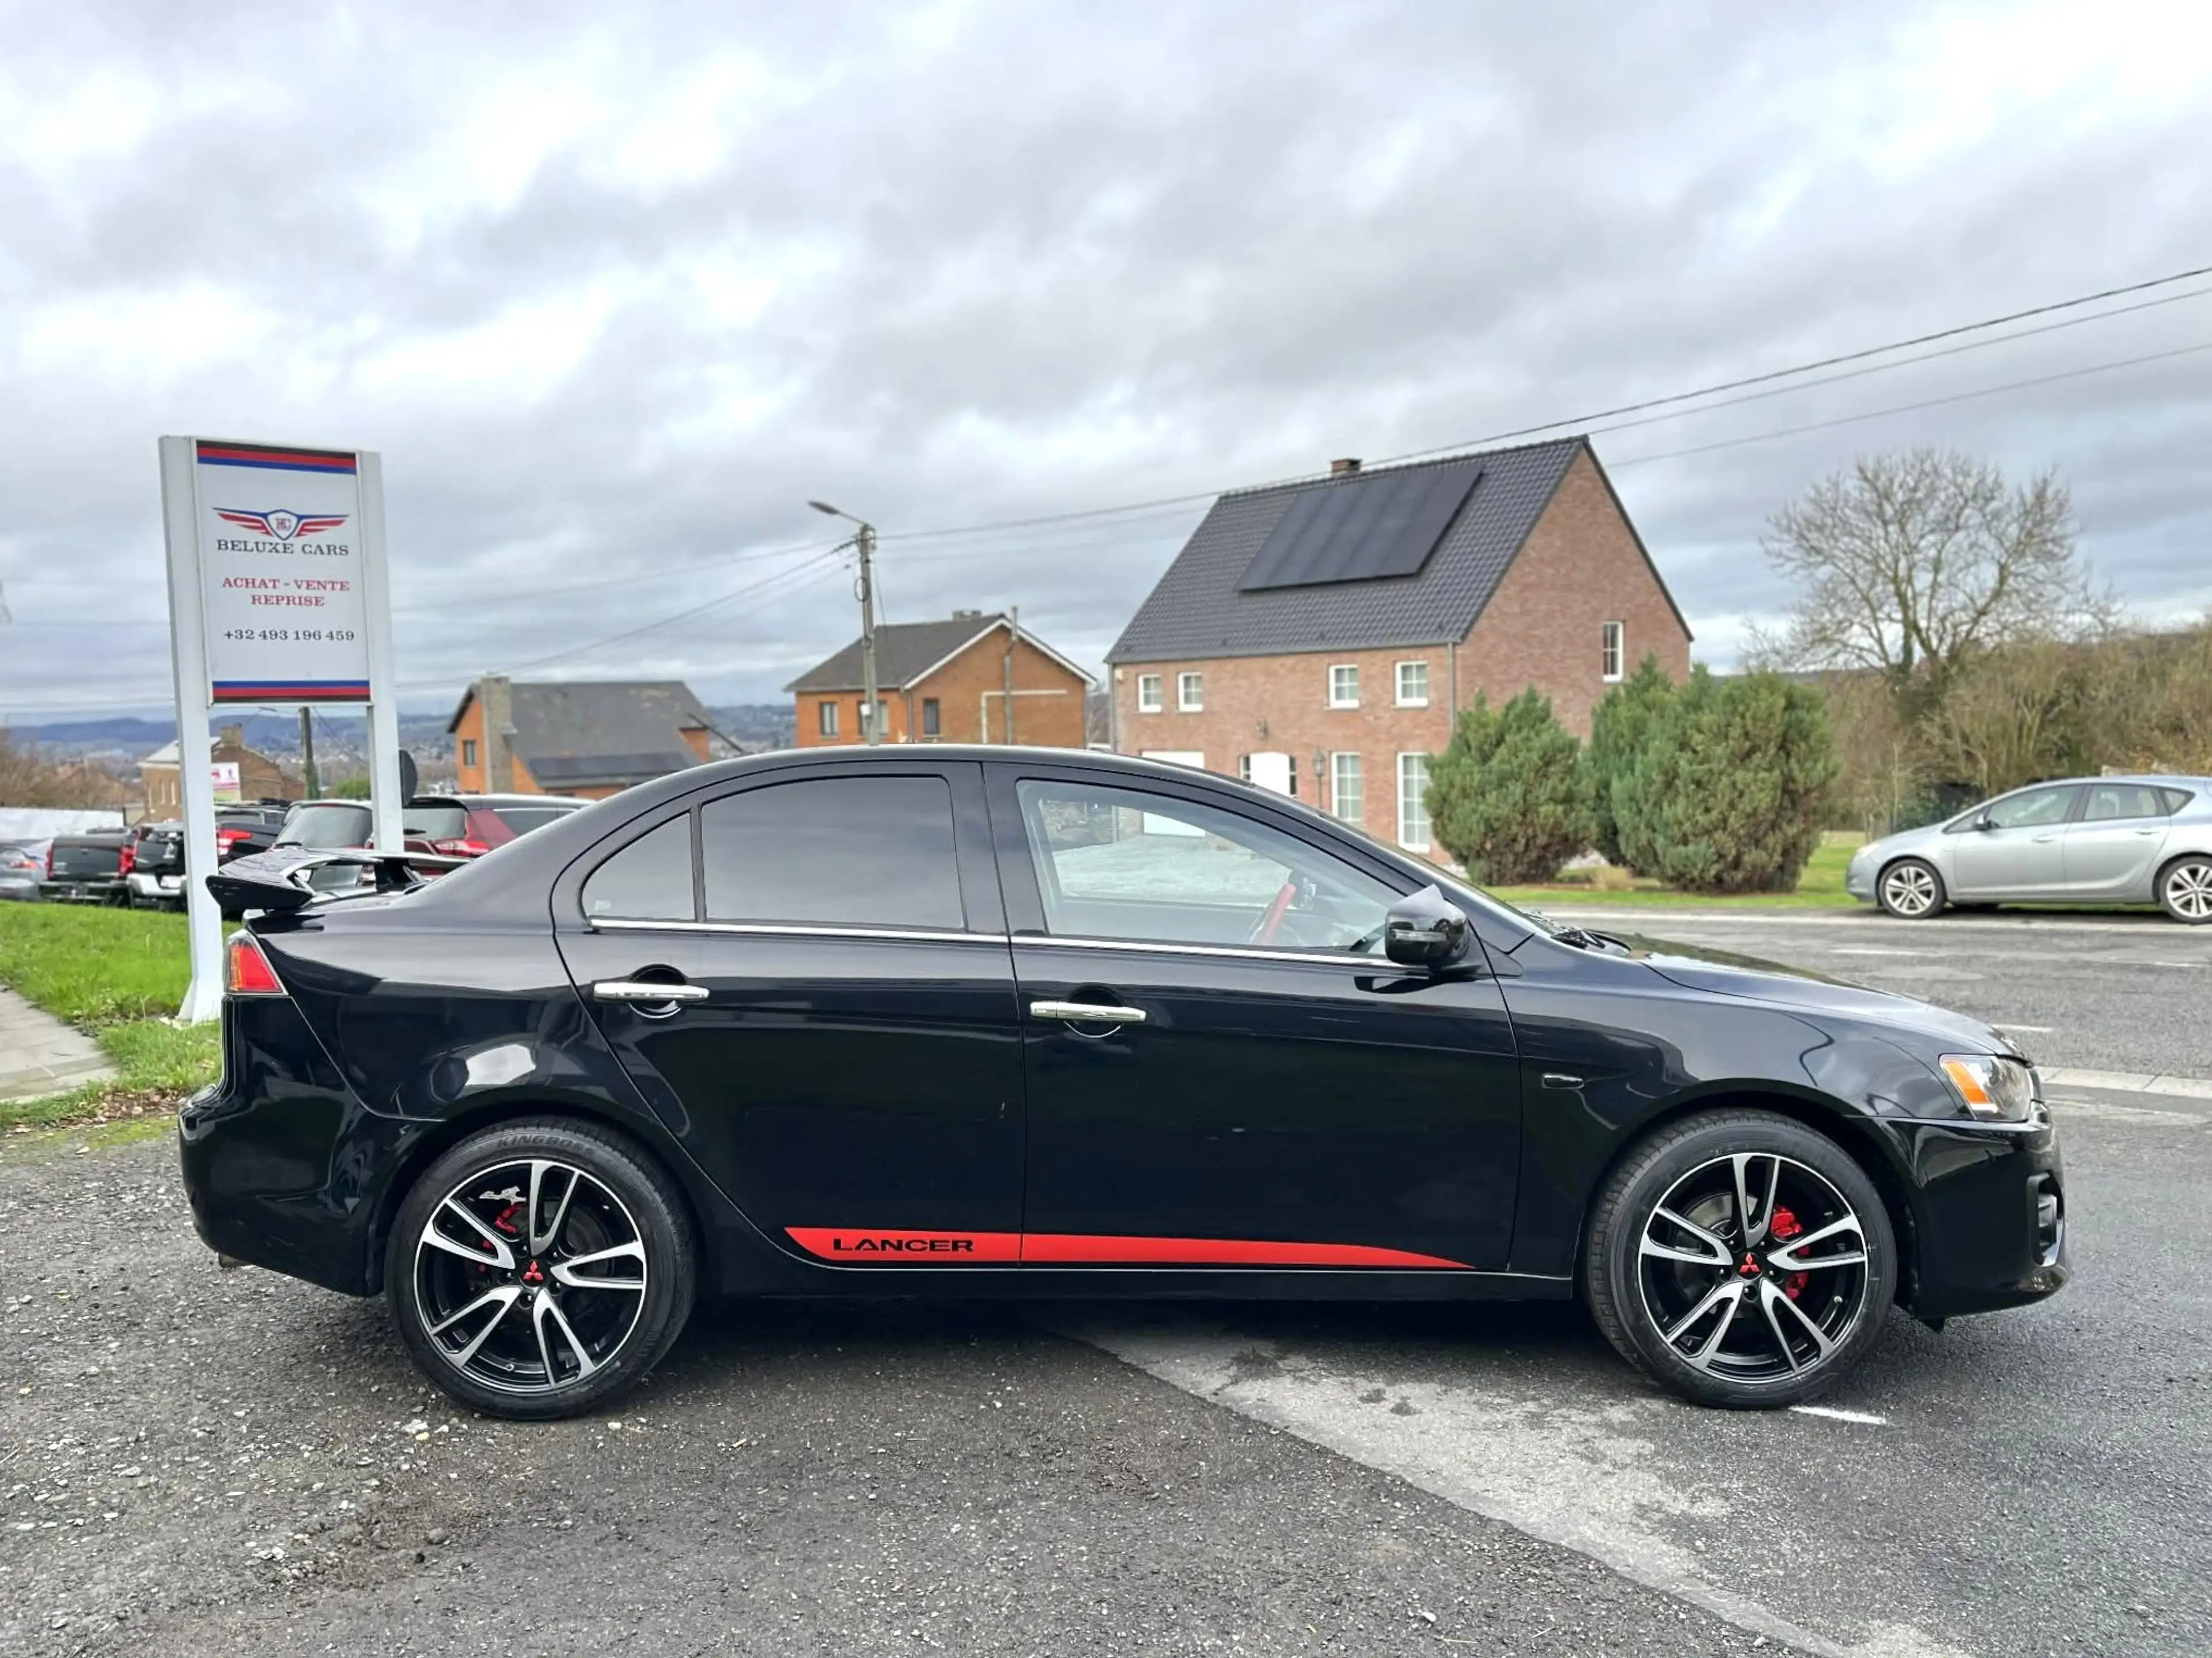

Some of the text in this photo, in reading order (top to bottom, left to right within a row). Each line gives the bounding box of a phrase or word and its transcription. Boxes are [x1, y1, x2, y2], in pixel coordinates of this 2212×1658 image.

[217, 539, 349, 556] BELUXE CARS
[222, 577, 280, 589] ACHAT
[294, 579, 350, 591] VENTE
[251, 594, 325, 606] REPRISE
[224, 629, 354, 641] +32 493 196 459
[833, 1238, 974, 1253] LANCER
